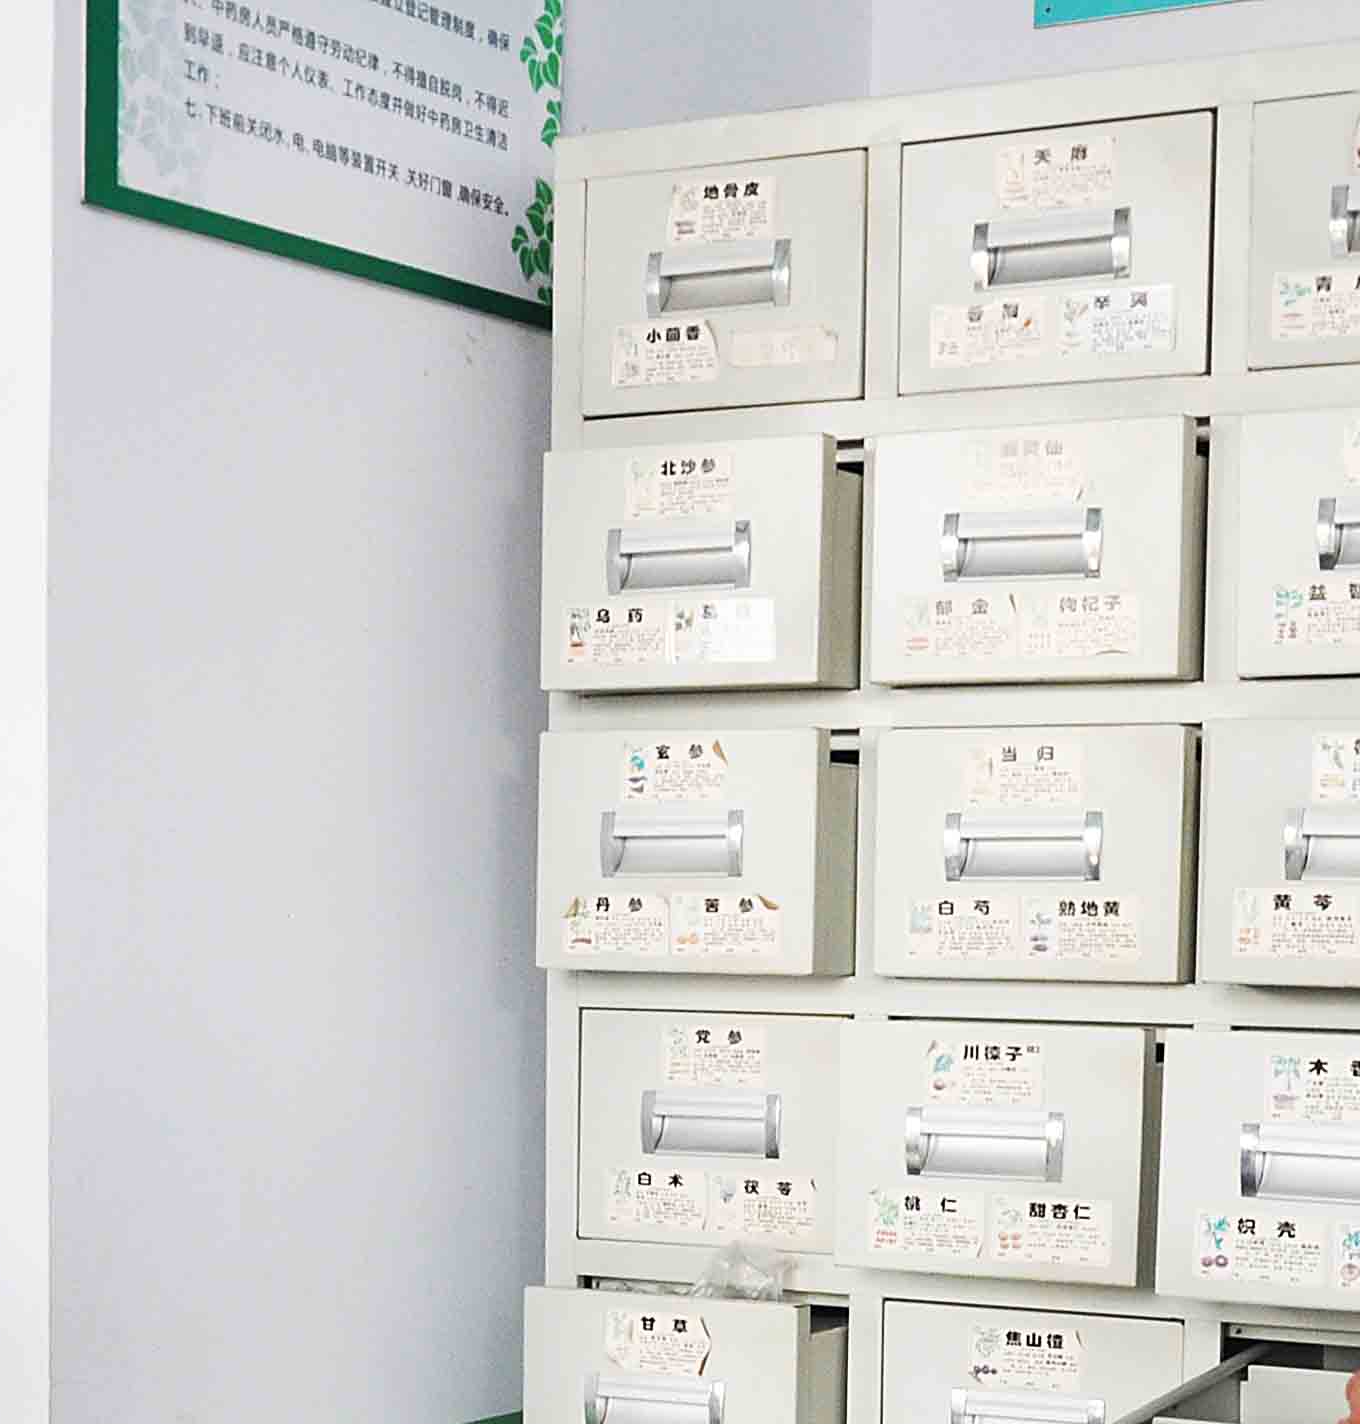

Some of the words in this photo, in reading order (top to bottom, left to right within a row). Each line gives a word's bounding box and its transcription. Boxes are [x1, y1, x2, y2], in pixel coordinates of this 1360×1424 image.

[704, 182, 759, 199] 地骨皮
[646, 326, 700, 343] 小茴香
[660, 458, 716, 476] 北沙参
[935, 599, 989, 616] 郁金
[596, 608, 644, 624] 乌药
[656, 744, 703, 760] 玄参
[1001, 746, 1054, 762] 当归
[596, 897, 643, 912] 丹参
[939, 900, 990, 916] 白芍
[1059, 901, 1121, 917] 熟地黄
[1273, 894, 1332, 910] 黄芩
[696, 1030, 742, 1045] 党参
[963, 1045, 1023, 1061] 川楝子
[638, 1172, 683, 1188] 白术
[744, 1180, 792, 1196] 茯苓
[905, 1196, 958, 1213] 桃仁
[1029, 1202, 1091, 1220] 甜杏仁
[1237, 1218, 1296, 1238] 枳壳
[641, 1316, 688, 1333] 甘草
[1006, 1331, 1064, 1349] 焦山楂
